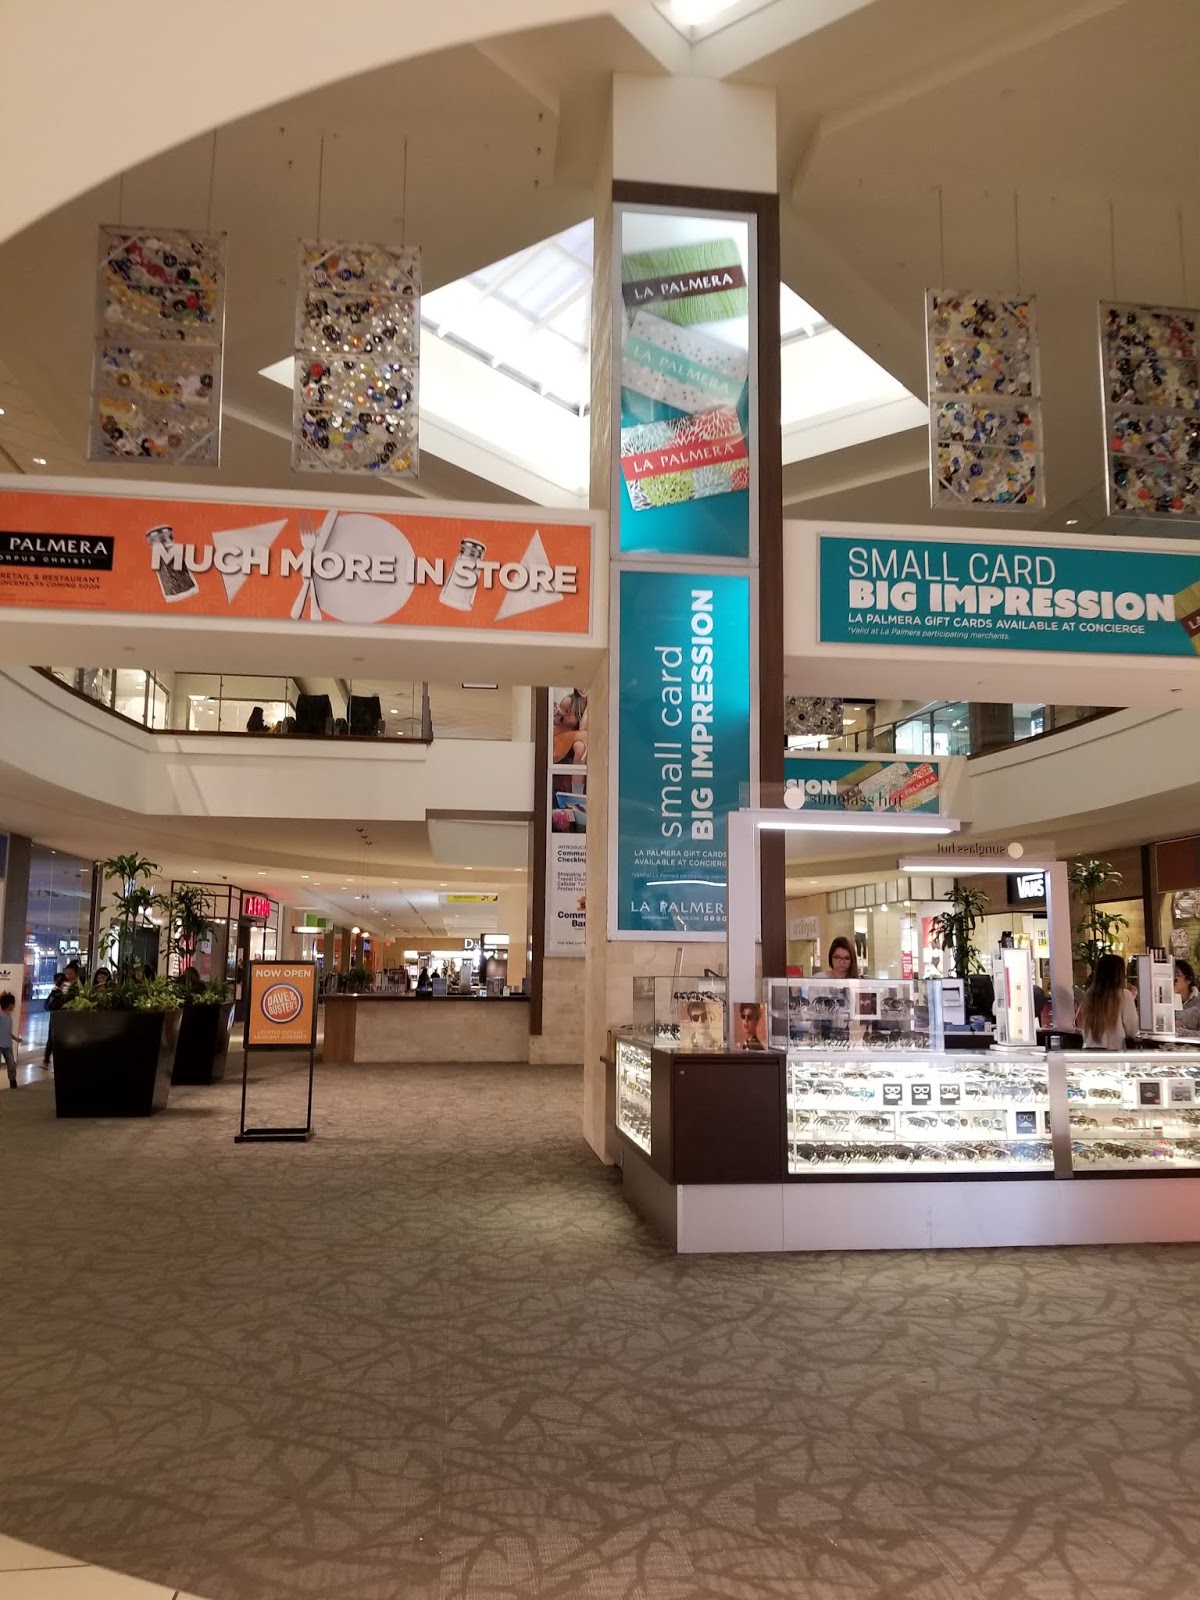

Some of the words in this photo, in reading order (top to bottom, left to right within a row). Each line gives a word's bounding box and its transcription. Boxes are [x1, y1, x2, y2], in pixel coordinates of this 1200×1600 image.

[634, 286, 654, 299] LA
[660, 272, 734, 295] PALMERA
[633, 346, 651, 362] LA
[659, 356, 730, 394] PALMERA
[633, 459, 654, 474] LA
[660, 442, 735, 467] PALMERA
[9, 536, 108, 555] PALMERA
[0, 554, 36, 563] ORPUS
[43, 556, 92, 566] CHRISTI
[151, 542, 270, 576] MUCH
[280, 547, 397, 583] MORE
[404, 556, 444, 586] IN
[453, 558, 578, 594] STORE
[848, 546, 960, 582] SMALL
[968, 552, 1057, 586] CARD
[0, 572, 30, 581] RETAIL
[42, 574, 100, 584] RESTAURANT
[0, 580, 44, 588] NCEMENTS
[848, 579, 918, 612] BIG
[929, 583, 1176, 622] IMPRESSION
[848, 612, 863, 624] LA
[866, 614, 922, 626] PALMERA
[925, 616, 951, 627] GIFT
[953, 617, 993, 629] CARDS
[996, 620, 1059, 632] AVAILABLE
[1062, 622, 1075, 631] AT
[1079, 624, 1146, 635] CONCIERGE
[880, 627, 890, 635] La
[891, 627, 921, 638] Palmera
[922, 629, 969, 641] participating
[654, 646, 683, 727] card
[691, 589, 714, 778] IMPRESSION
[654, 742, 683, 838] small
[810, 792, 875, 809] sunglass
[878, 791, 903, 808] hut
[691, 787, 714, 841] BIG
[634, 849, 644, 857] LA
[646, 849, 681, 857] PALMERA
[683, 850, 701, 858] GIFT
[634, 858, 676, 867] AVAILABLE
[677, 859, 687, 867] AT
[1016, 873, 1045, 899] VANS
[557, 910, 587, 919] Comm
[630, 901, 650, 913] LA
[660, 900, 725, 914] PALMER
[255, 969, 282, 978] NOW
[283, 969, 312, 978] OPEN
[267, 991, 290, 1006] DAVE
[290, 991, 298, 1001] &
